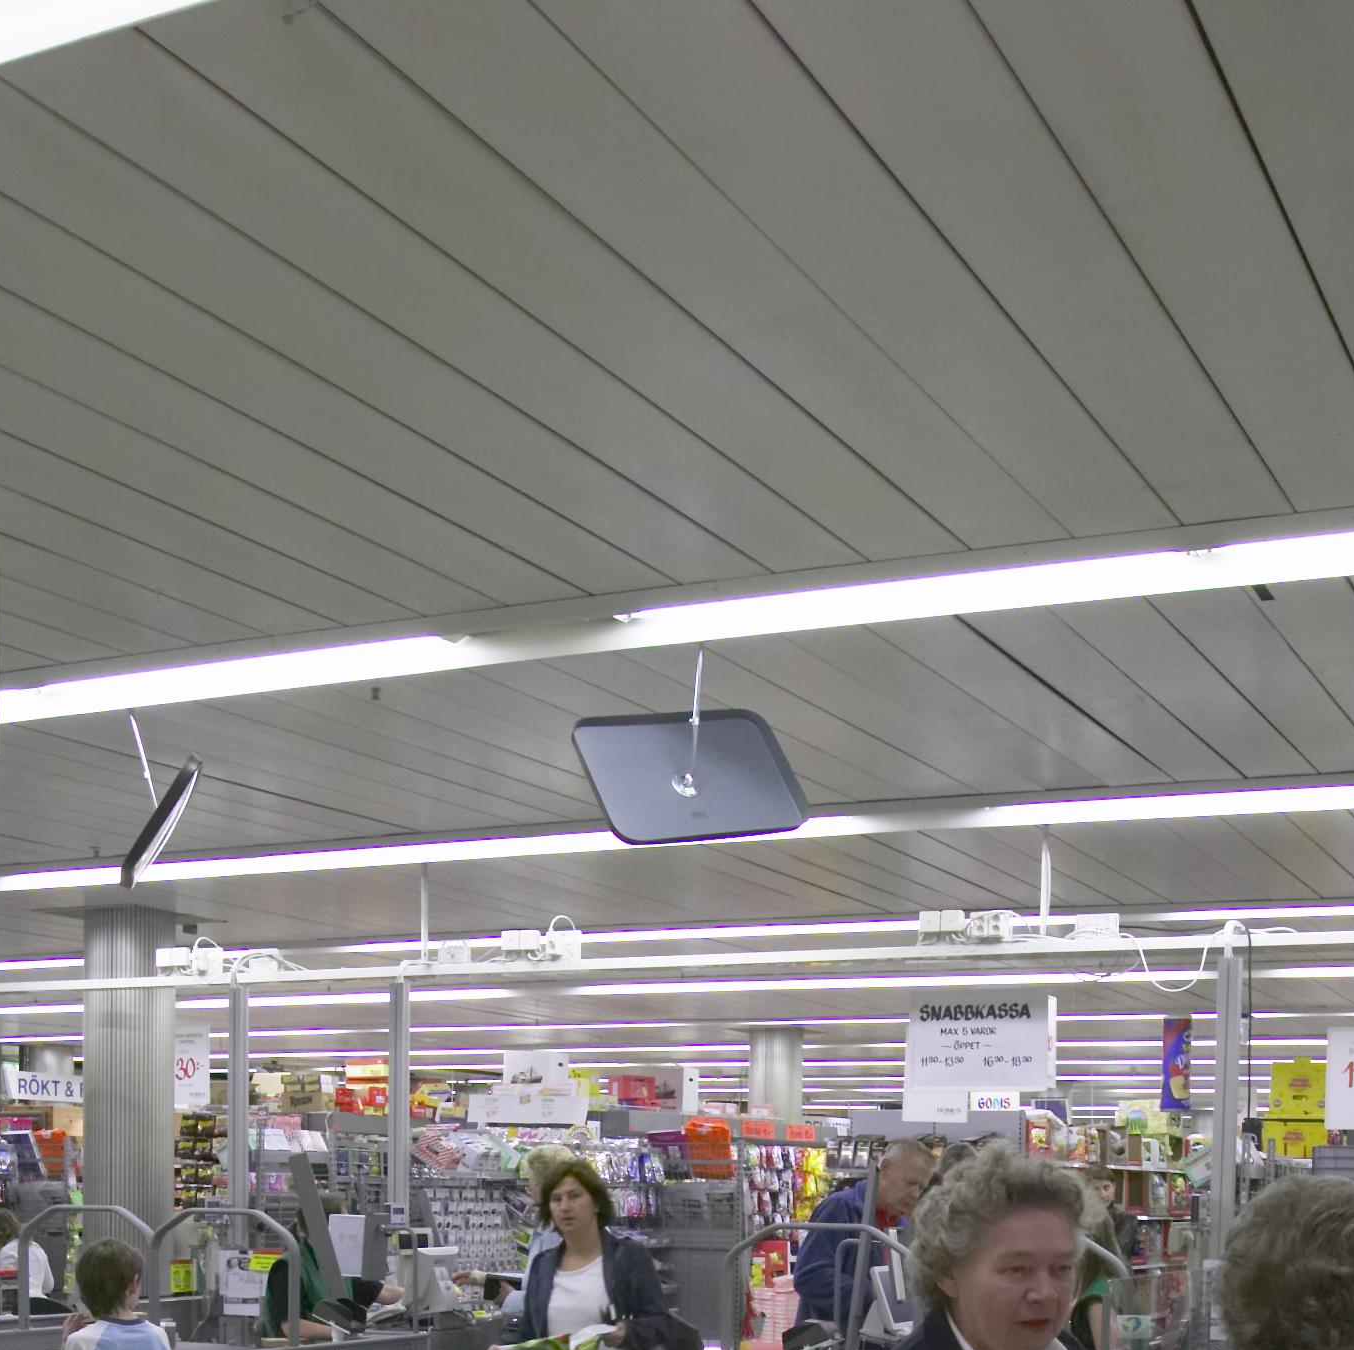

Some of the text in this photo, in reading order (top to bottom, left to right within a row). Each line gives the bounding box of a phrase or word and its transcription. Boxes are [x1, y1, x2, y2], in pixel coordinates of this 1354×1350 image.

[919, 1003, 1031, 1023] SNABBKASSA
[940, 1027, 959, 1036] MAX
[970, 1026, 997, 1036] VAROR
[18, 1075, 60, 1097] RÖKT
[64, 1082, 74, 1097] &
